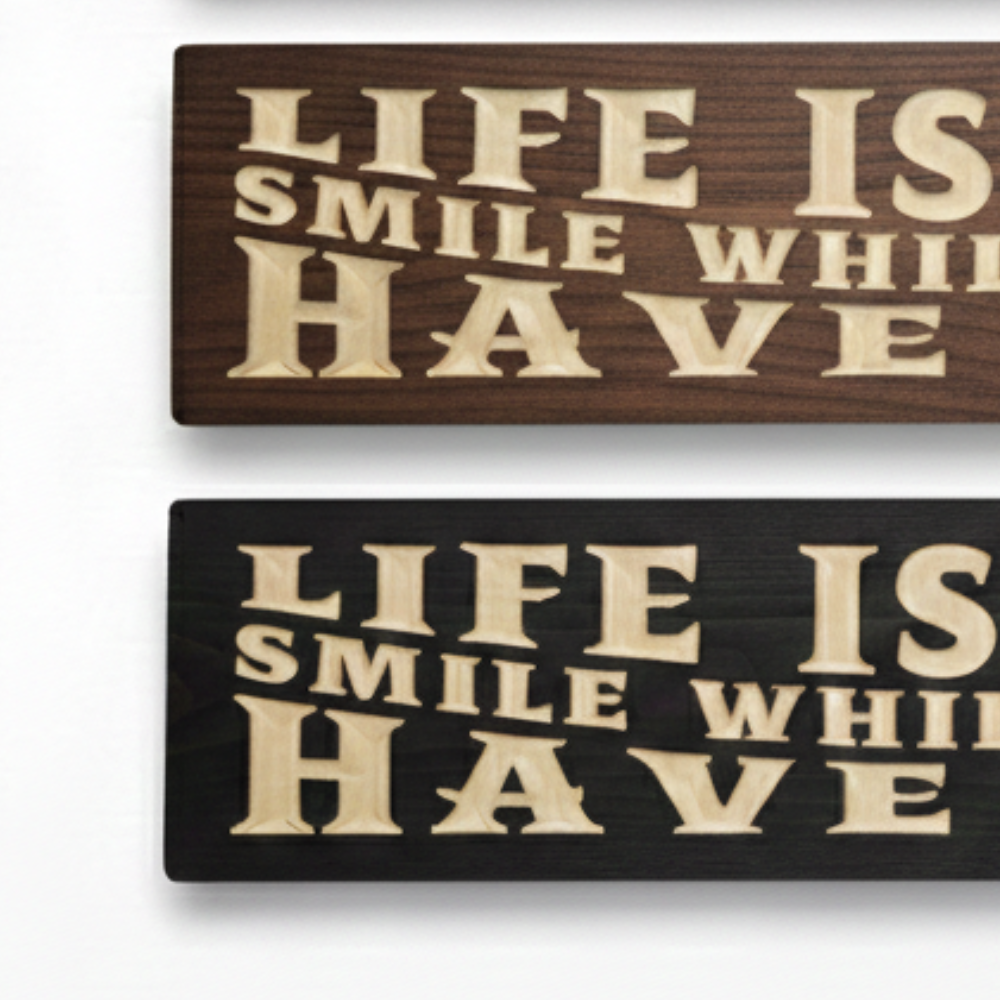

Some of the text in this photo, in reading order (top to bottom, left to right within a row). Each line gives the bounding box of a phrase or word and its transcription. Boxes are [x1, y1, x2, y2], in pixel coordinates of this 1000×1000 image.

[234, 167, 625, 275] SMILE
[238, 87, 698, 209] LIFE
[793, 87, 993, 223] IS
[227, 237, 946, 378] HAVE
[236, 625, 627, 731] SMILE
[238, 544, 700, 664] LIFE
[798, 544, 996, 679] IS
[230, 694, 952, 835] HAVE
